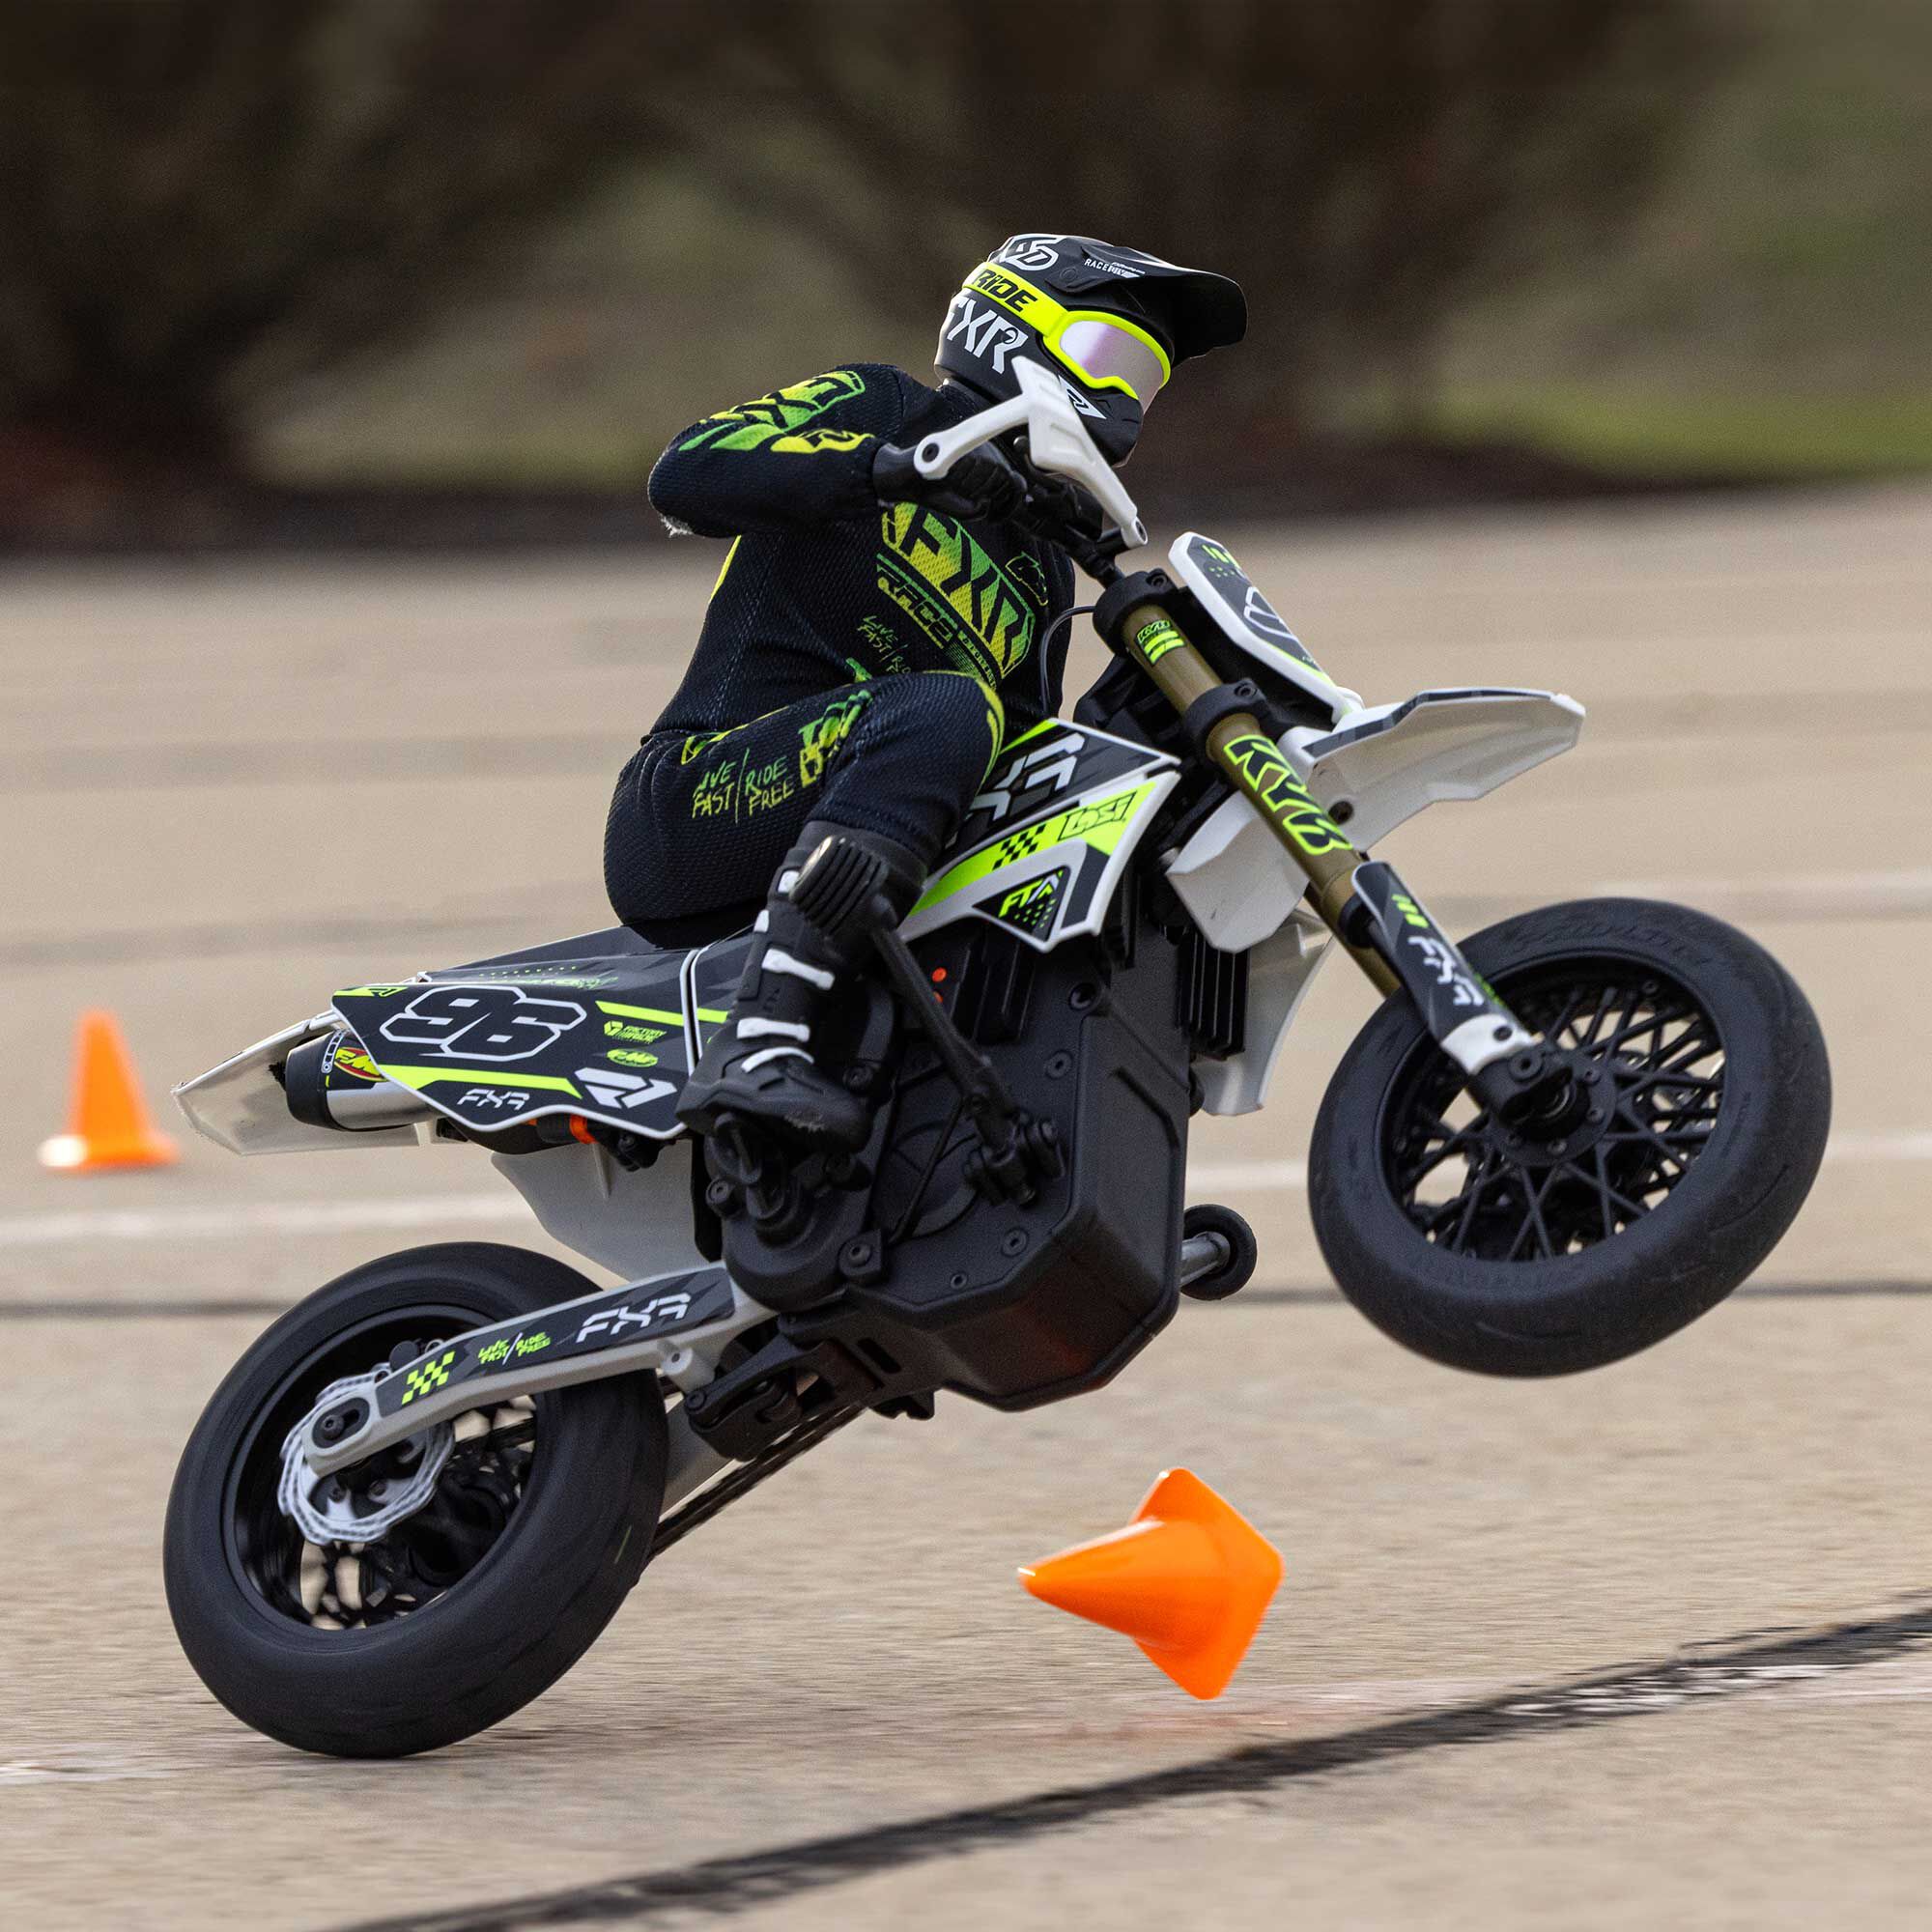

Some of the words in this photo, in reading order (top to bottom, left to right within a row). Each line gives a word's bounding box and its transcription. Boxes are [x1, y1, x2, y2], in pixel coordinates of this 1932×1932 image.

[972, 269, 1038, 313] RIDE
[745, 756, 789, 797] RIDE
[749, 777, 795, 817] FREE
[966, 731, 1086, 822] XR
[1224, 733, 1353, 855] KYB
[692, 782, 734, 819] FAST
[379, 984, 587, 1063] 96
[457, 1088, 530, 1111] FXR
[576, 1292, 692, 1344] FXR
